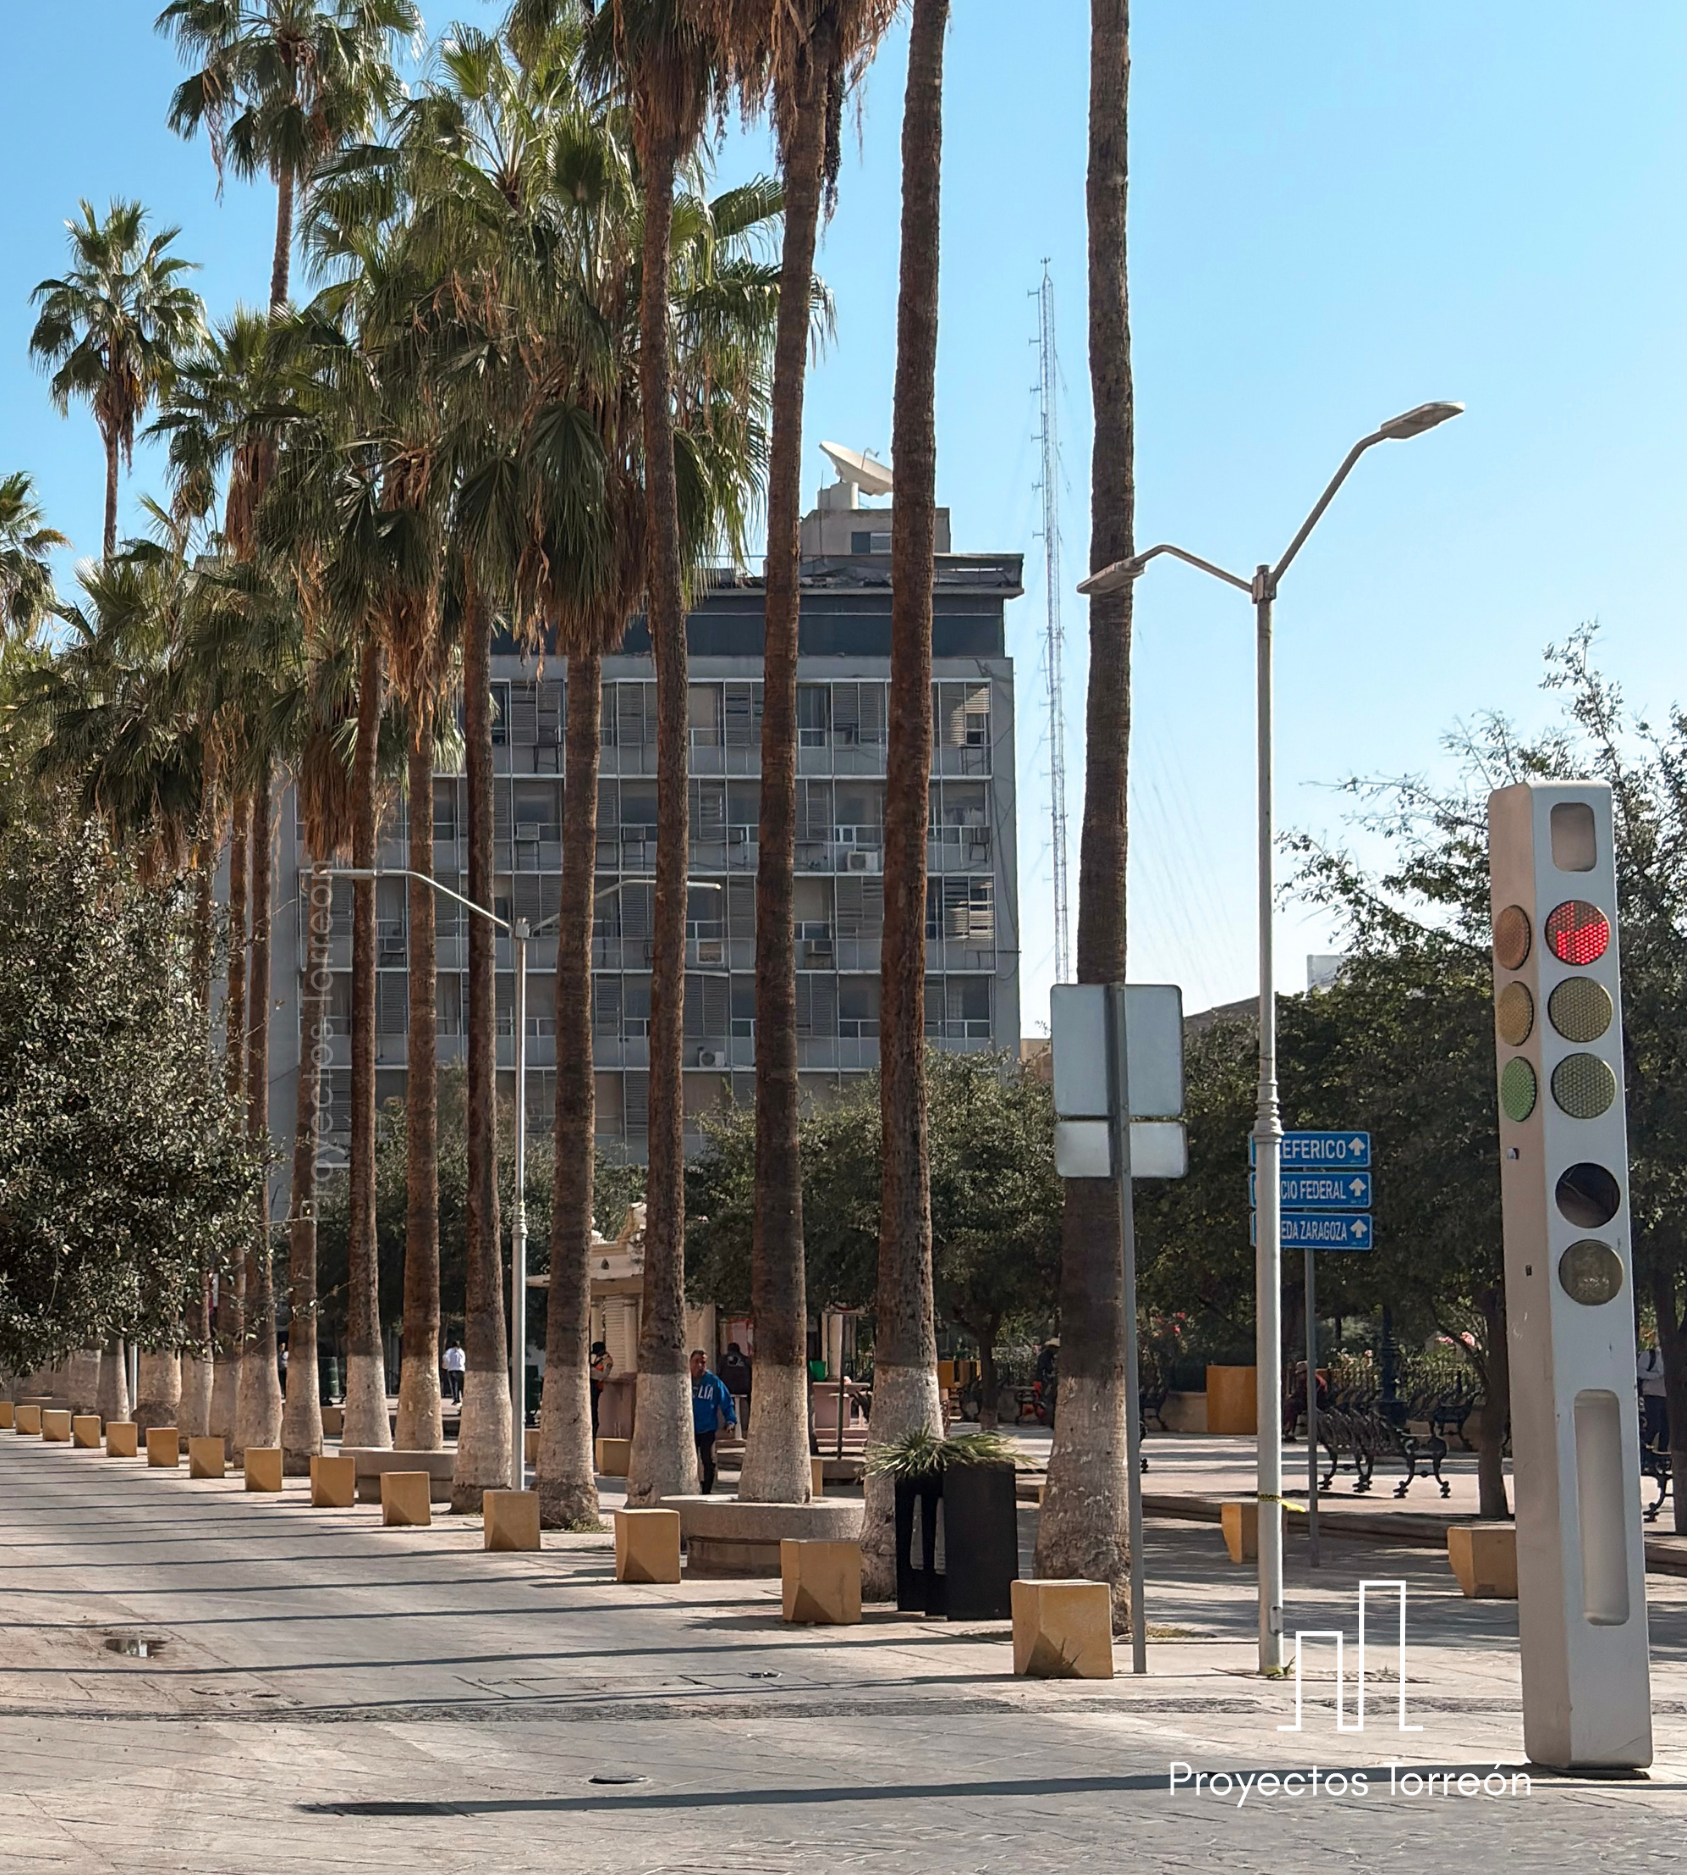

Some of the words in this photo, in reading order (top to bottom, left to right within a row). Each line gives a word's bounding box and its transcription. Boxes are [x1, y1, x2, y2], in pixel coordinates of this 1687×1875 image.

[1280, 1139, 1347, 1159] EFERICO
[1300, 1180, 1347, 1199] FEDERAL
[1300, 1220, 1348, 1241] ZARAGOZA
